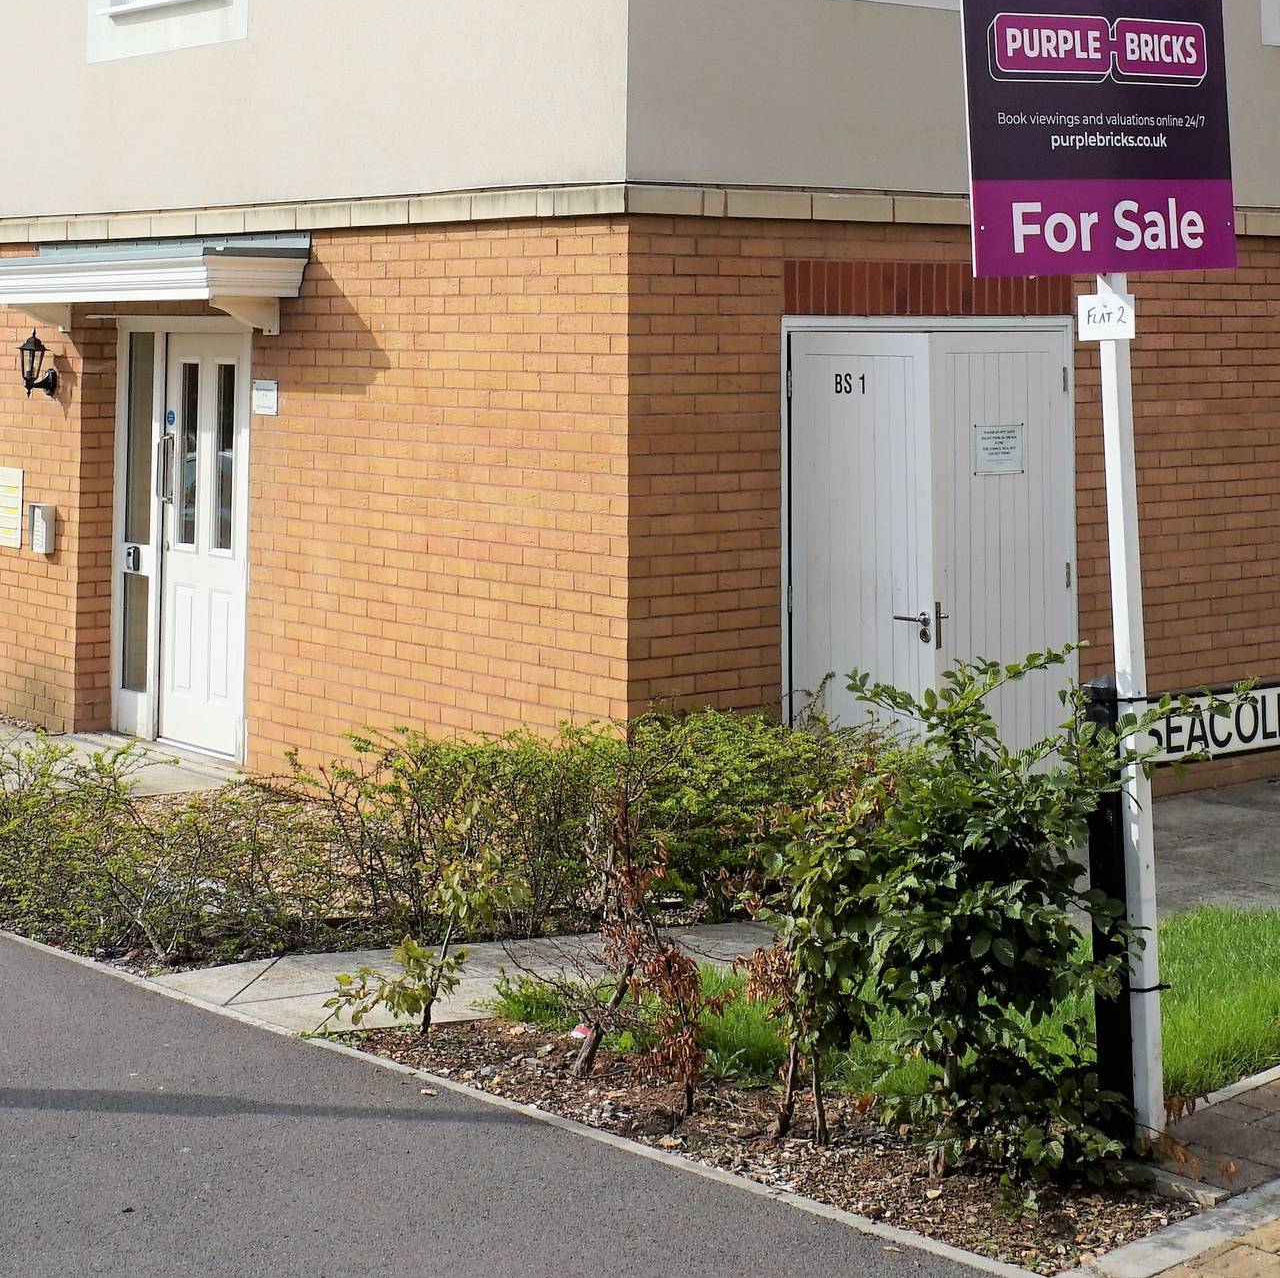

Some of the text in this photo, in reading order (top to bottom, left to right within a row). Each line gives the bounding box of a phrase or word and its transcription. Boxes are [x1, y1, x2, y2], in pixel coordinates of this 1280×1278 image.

[1005, 28, 1198, 64] PURPLE BRICKS
[997, 112, 1206, 128] Book viewings and valuations online 24/7
[1051, 131, 1168, 150] purplebricks.co.uk
[1012, 197, 1205, 253] For Sale
[1087, 306, 1127, 325] FLAT 2
[834, 373, 867, 395] BS 1
